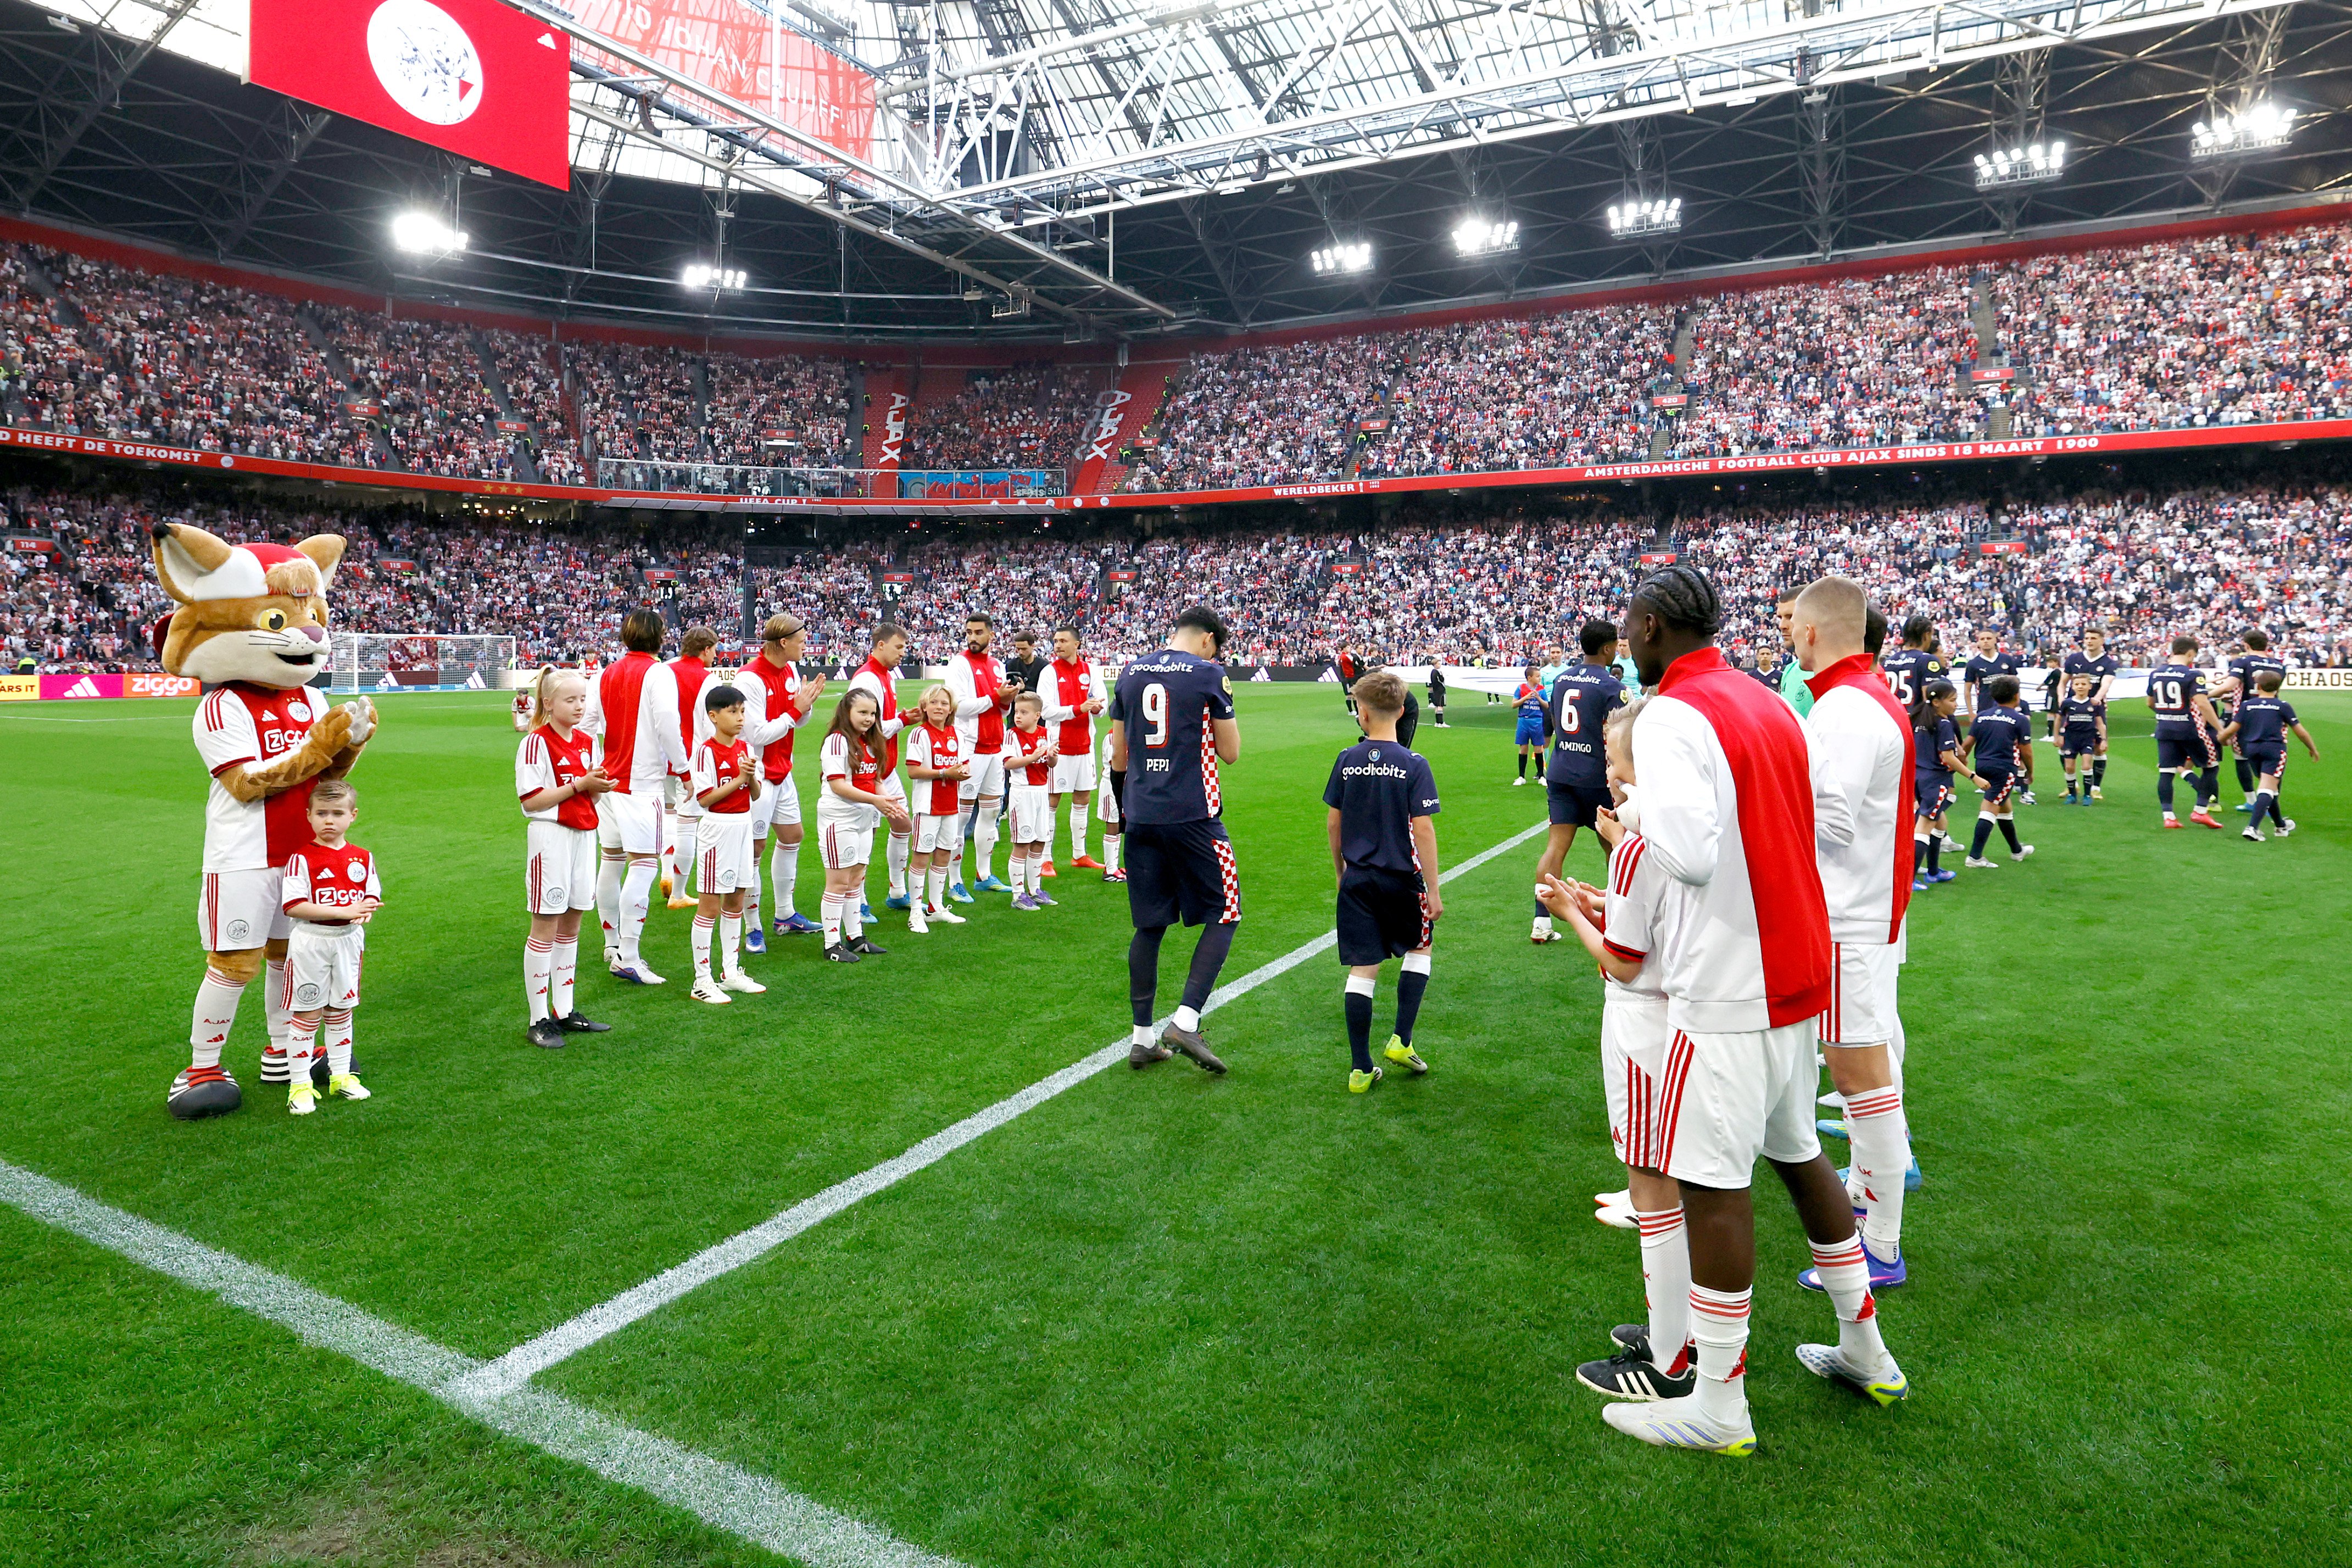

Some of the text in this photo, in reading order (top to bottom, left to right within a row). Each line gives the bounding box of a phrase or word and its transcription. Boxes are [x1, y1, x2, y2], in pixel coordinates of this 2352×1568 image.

[662, 20, 746, 79] JOHAN
[879, 393, 909, 464] AJAX
[1085, 390, 1132, 461] AJAX
[18, 433, 76, 448] HEEFT
[84, 440, 106, 452] DE
[112, 443, 202, 462] TOEKOMST
[1585, 438, 2098, 477] AMSTERDAMSCHE FOOTBALL CLUB AJAX SINDS 18 MAART 1900
[1273, 483, 1355, 496] WERELDBEKER
[711, 670, 735, 680] AOS
[1129, 661, 1194, 676] goodhabitz
[1558, 674, 1601, 684] goodhabitz
[2287, 672, 2352, 686] CHAOS
[132, 674, 192, 696] ziggo
[2152, 680, 2183, 709] 19
[1142, 683, 1169, 748] 9
[1560, 688, 1581, 734] 6
[1559, 741, 1591, 753] AMINGO
[1146, 758, 1169, 772] PEPI
[1342, 763, 1407, 780] goodhabitz
